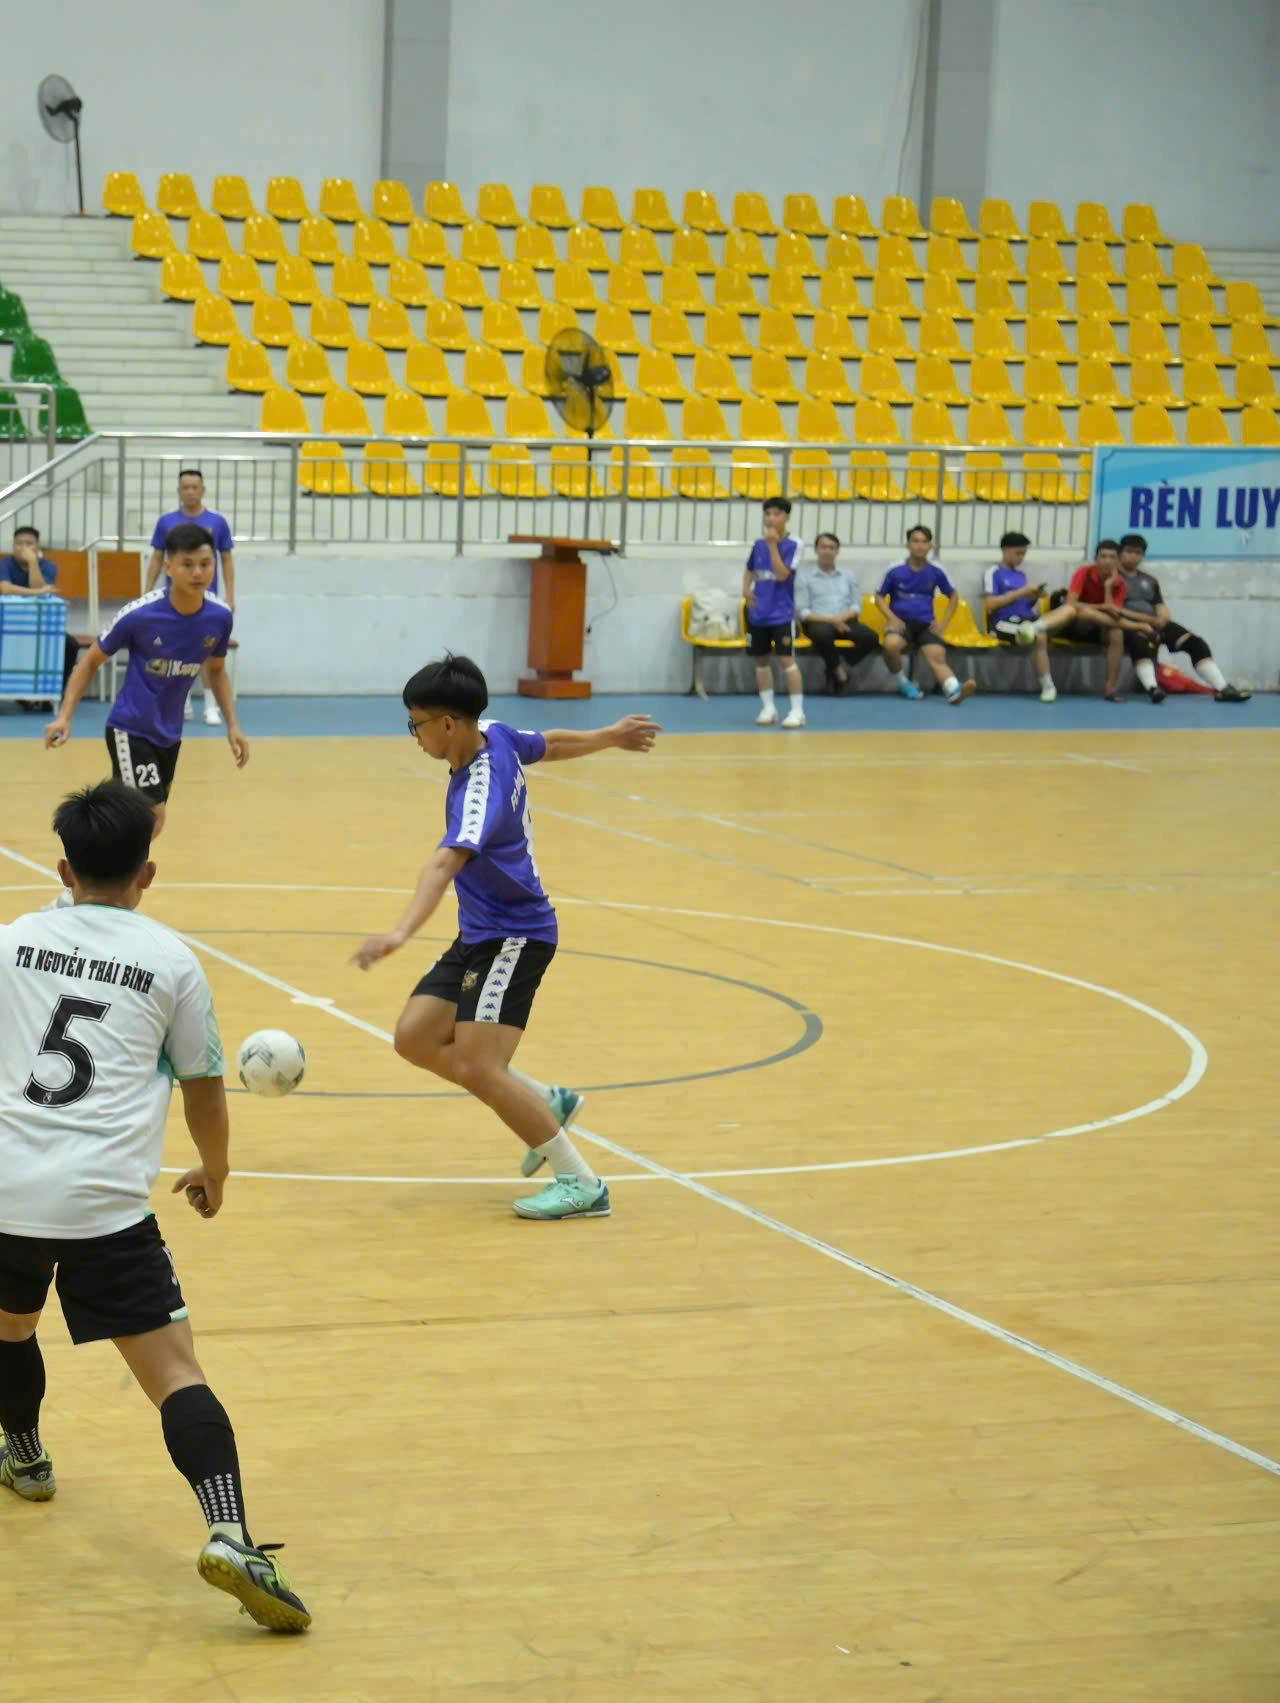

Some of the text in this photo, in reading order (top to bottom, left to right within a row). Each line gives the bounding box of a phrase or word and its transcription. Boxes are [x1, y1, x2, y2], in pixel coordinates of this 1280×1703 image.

[1128, 478, 1203, 529] RÈN
[135, 762, 161, 788] 23
[15, 945, 155, 994] TH NGUYỄN THÁI BÌNH
[23, 993, 112, 1109] 5
